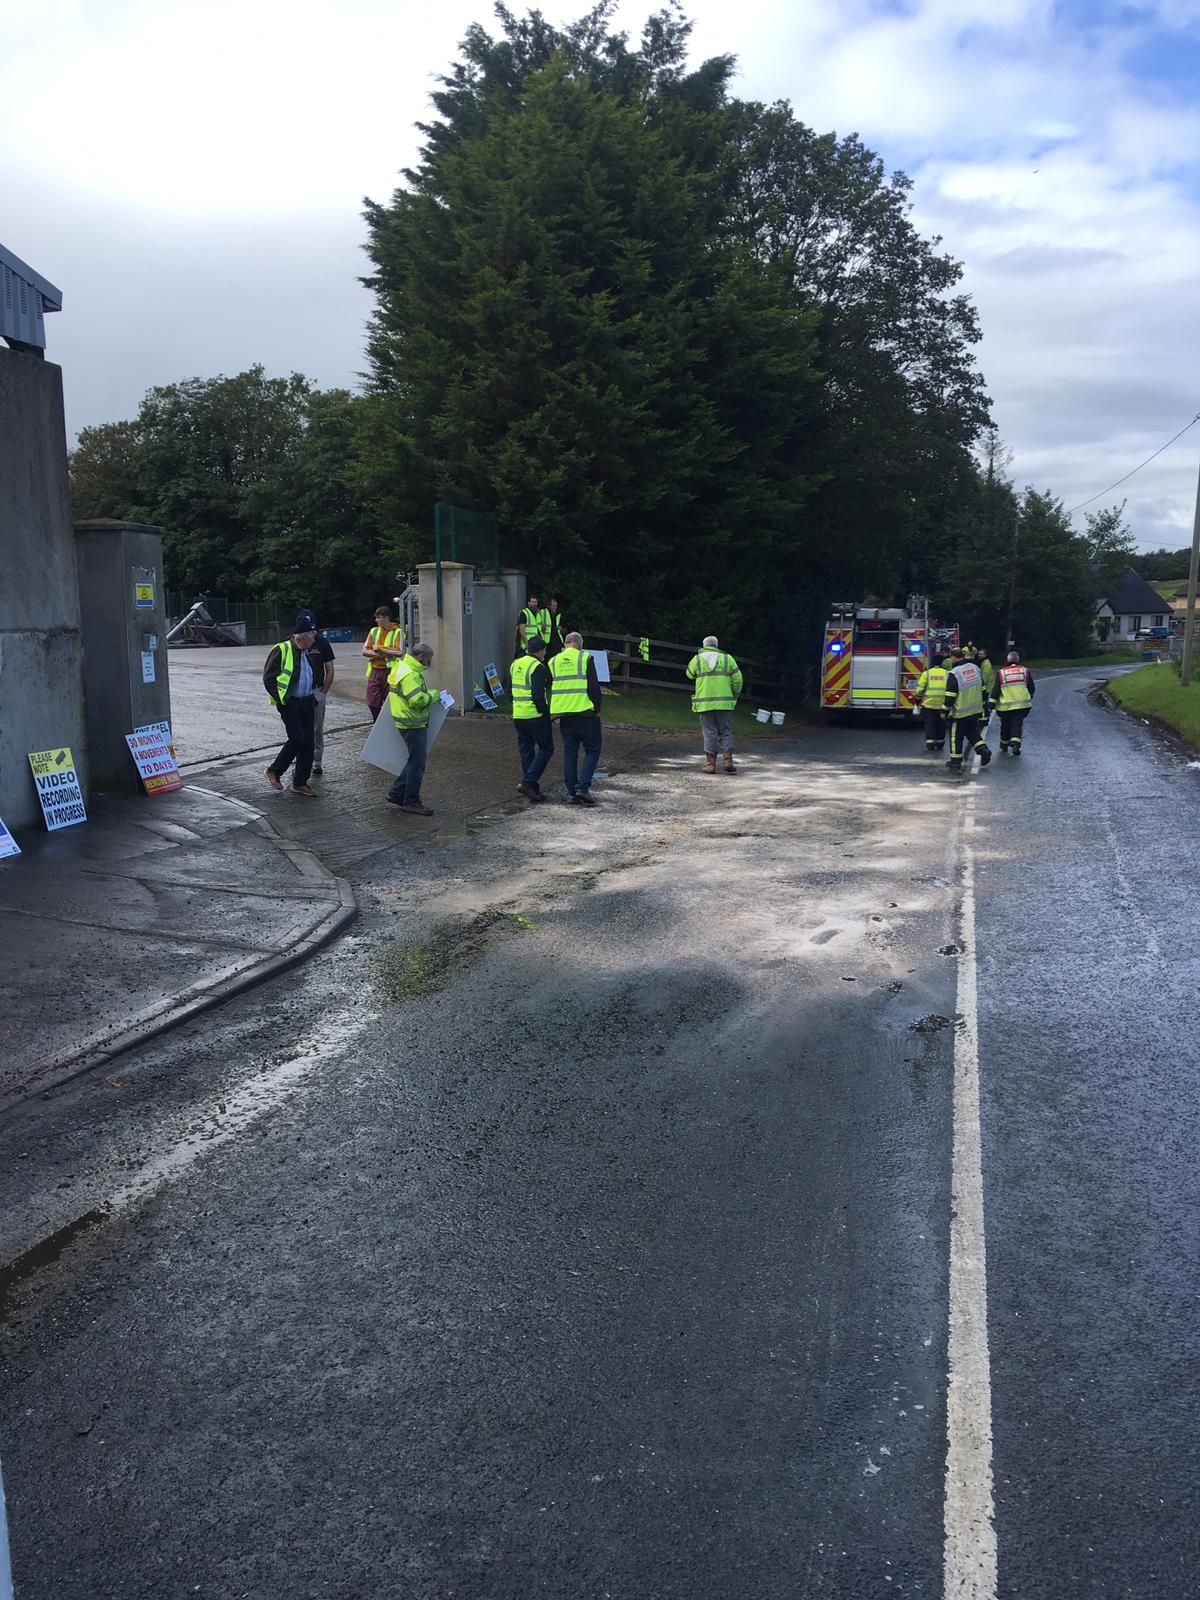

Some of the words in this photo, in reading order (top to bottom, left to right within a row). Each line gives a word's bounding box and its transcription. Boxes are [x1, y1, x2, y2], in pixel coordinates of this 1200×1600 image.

[138, 734, 164, 746] MONTHS
[30, 752, 52, 764] PLEASE
[138, 746, 168, 760] MOVEMENTS
[34, 763, 50, 774] NOTE
[141, 764, 152, 774] 70
[153, 760, 173, 772] DAYS
[37, 771, 76, 789] VIDEO
[41, 786, 80, 808] RECORDING
[46, 811, 54, 826] IN
[54, 804, 84, 824] PROGRESS
